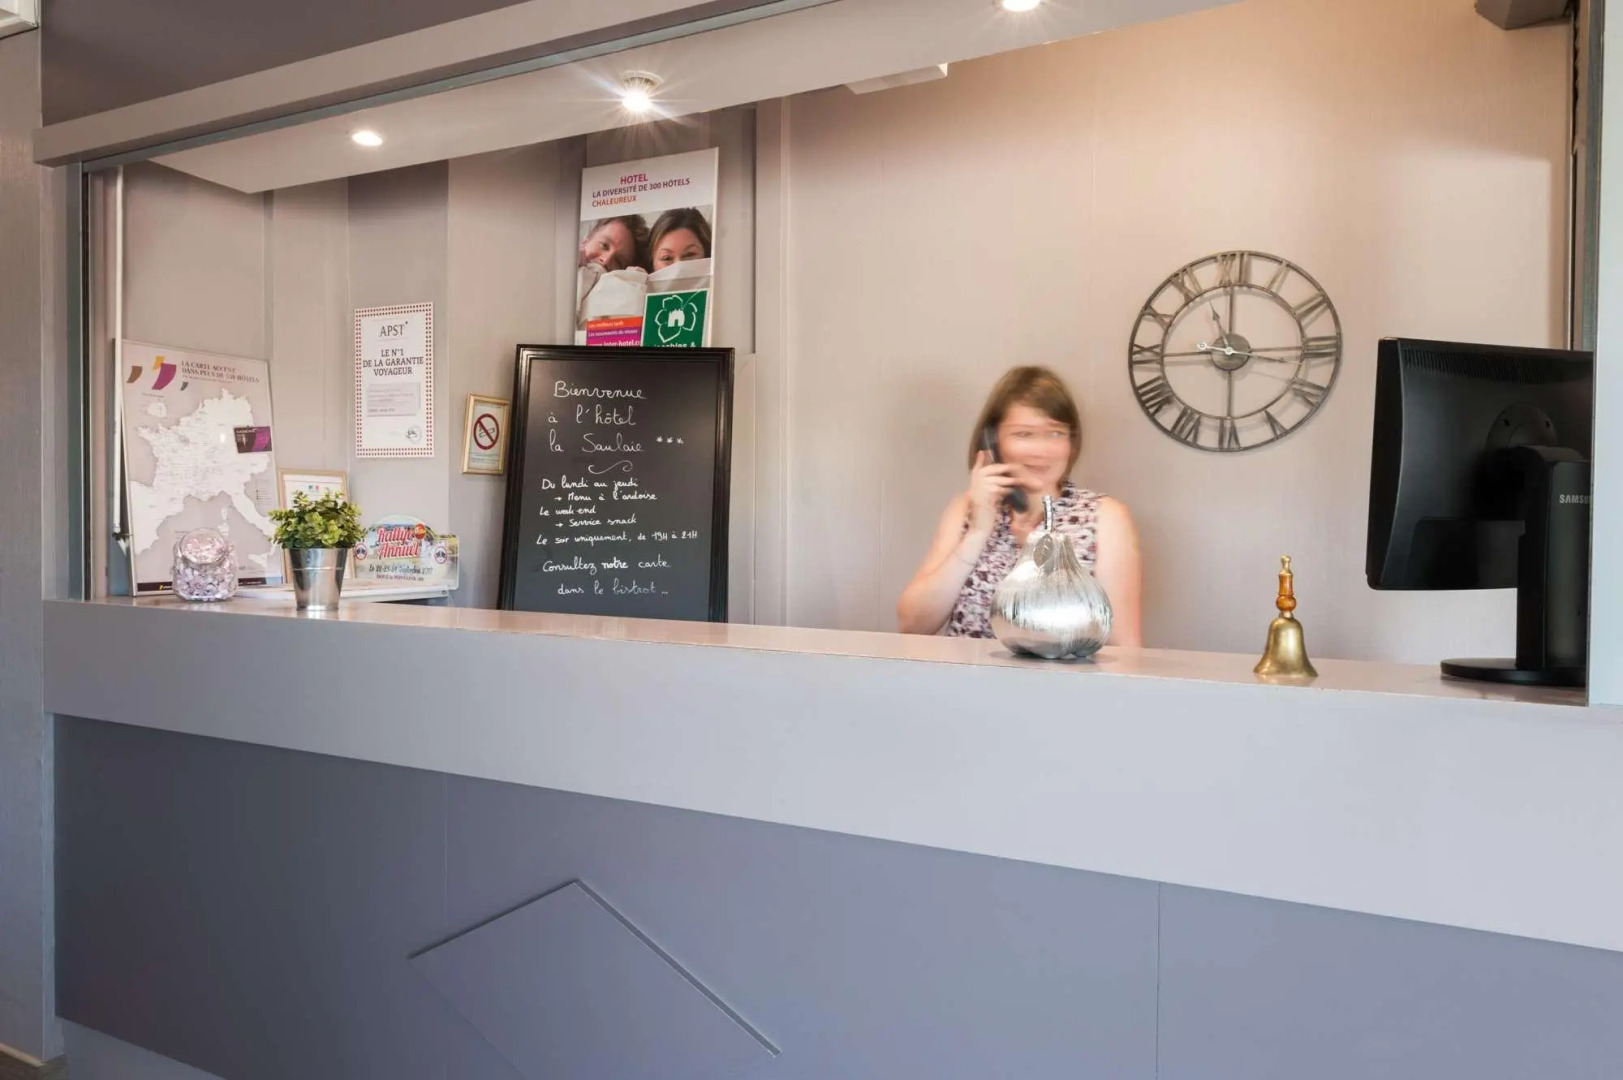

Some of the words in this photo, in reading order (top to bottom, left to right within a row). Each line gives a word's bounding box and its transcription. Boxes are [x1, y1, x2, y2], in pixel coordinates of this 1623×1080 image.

[620, 173, 648, 185] HOTEL
[592, 190, 601, 198] LA
[602, 184, 637, 196] DIVERSITÉ
[638, 184, 648, 192] DE
[649, 182, 662, 190] 300
[662, 178, 690, 188] HÔTELS
[592, 195, 637, 208] CHALEUREUX
[381, 350, 390, 358] LE
[363, 360, 372, 368] DE
[374, 359, 384, 367] LA
[386, 356, 424, 366] GARANTIE
[374, 366, 413, 376] VOYAGEUR
[554, 380, 648, 399] Bienvenue
[548, 412, 558, 423] à
[549, 428, 564, 452] la
[582, 432, 645, 453] Saulaie
[542, 478, 556, 490] Du
[562, 474, 588, 488] lundi
[613, 478, 638, 491] jeudi
[568, 492, 592, 501] Menu
[612, 490, 658, 501] l'ardoise
[539, 506, 550, 516] Le
[568, 518, 602, 527] Service
[607, 514, 637, 525] snack
[536, 534, 548, 545] Le
[638, 532, 646, 540] de
[652, 531, 668, 541] 19H
[672, 531, 678, 540] à
[681, 530, 698, 539] 21H
[542, 556, 598, 575] Consultez
[601, 556, 628, 569] notre
[638, 554, 672, 568] carte
[558, 584, 584, 595] dans
[594, 580, 604, 595] le
[612, 578, 656, 595] bistrot
